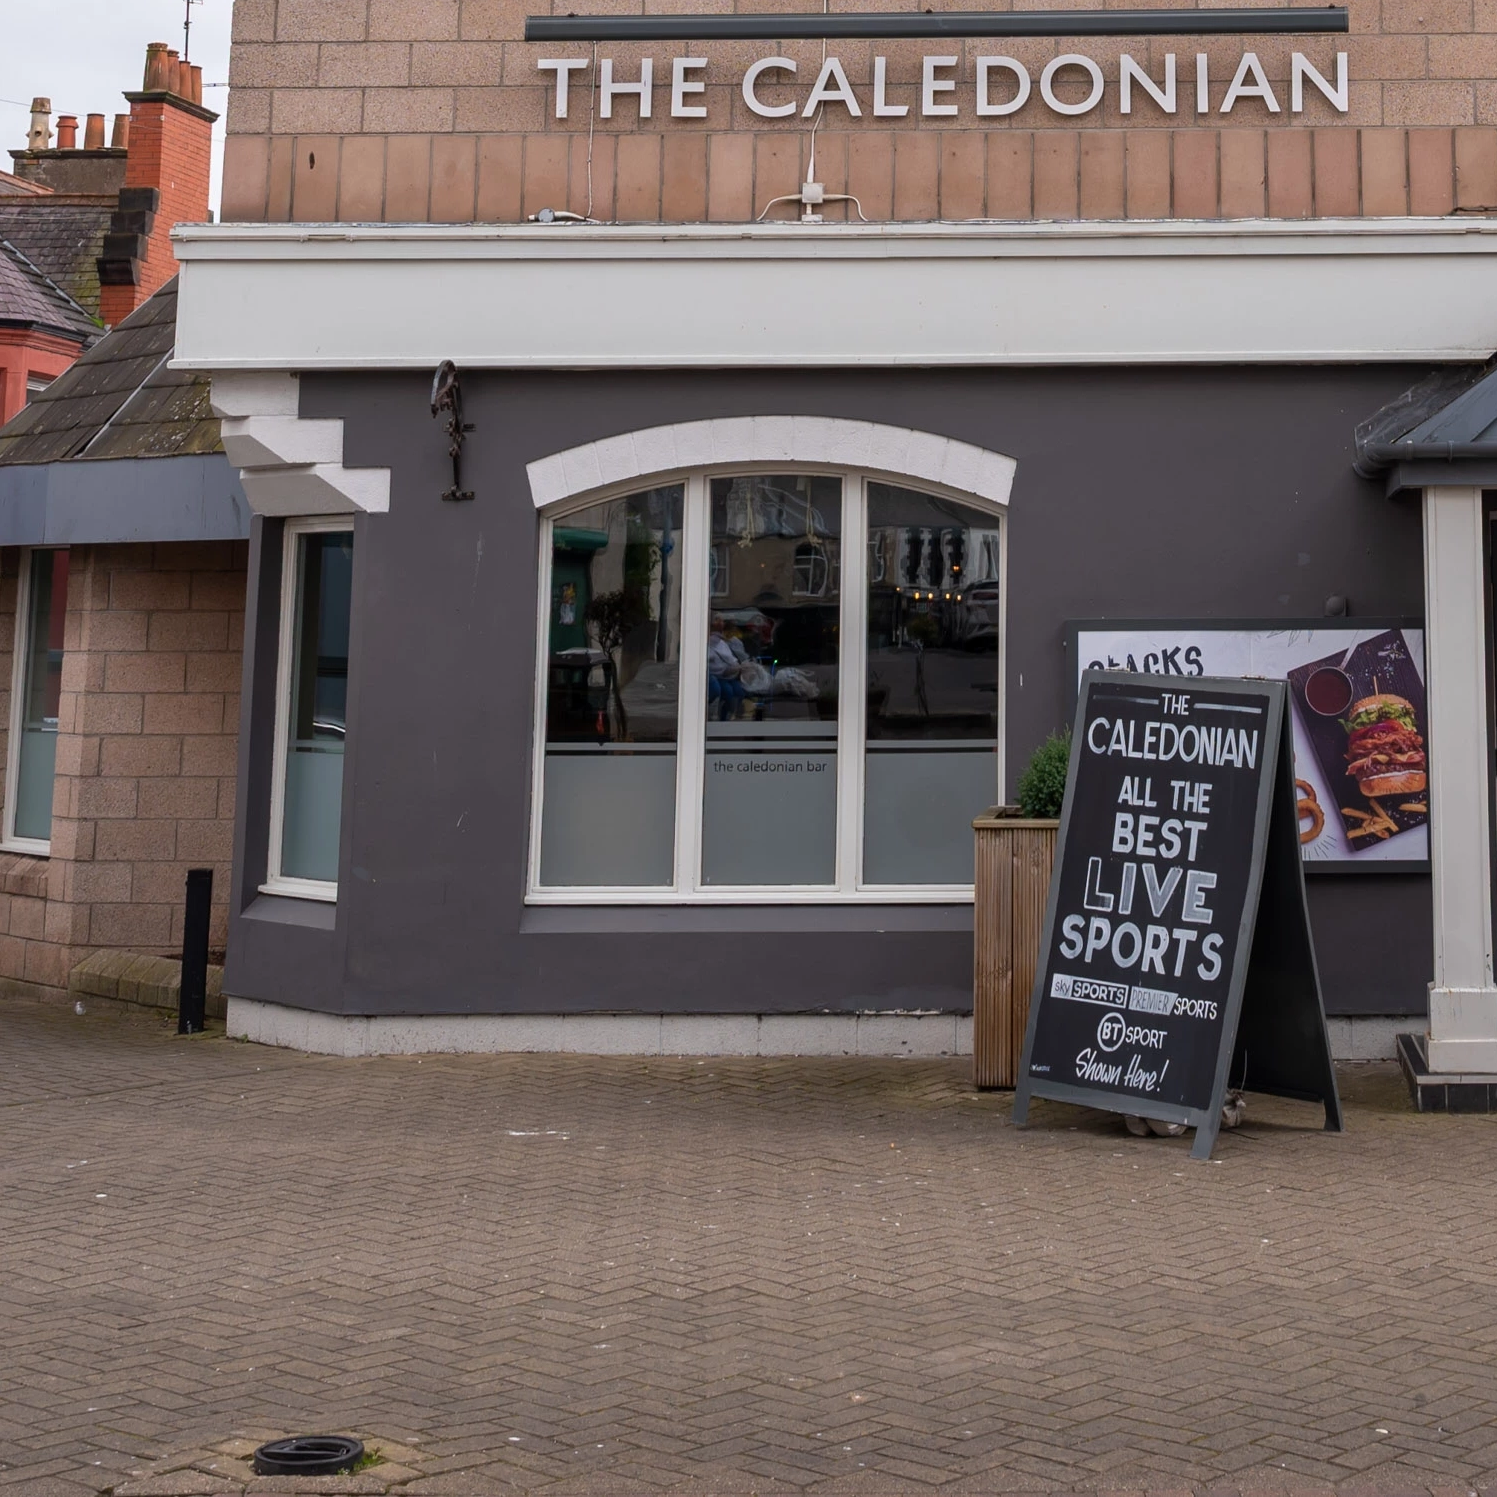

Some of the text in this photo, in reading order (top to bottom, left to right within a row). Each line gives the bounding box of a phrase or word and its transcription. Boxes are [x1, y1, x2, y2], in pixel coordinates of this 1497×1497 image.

[537, 51, 1350, 119] THE CALEDONIAN
[1161, 693, 1190, 715] THE
[1087, 717, 1259, 769] CALEDONIAN
[713, 760, 827, 772] the caledonian bar
[1117, 775, 1213, 814] ALL THE
[1112, 812, 1208, 861] BEST
[1083, 856, 1217, 925] LIVE
[1059, 914, 1224, 981] SPORTS
[1054, 979, 1218, 1020] sky SPORTS PREMIER SPORTS
[1101, 1021, 1167, 1049] BT SPORT
[1075, 1047, 1170, 1092] Shown Here!
